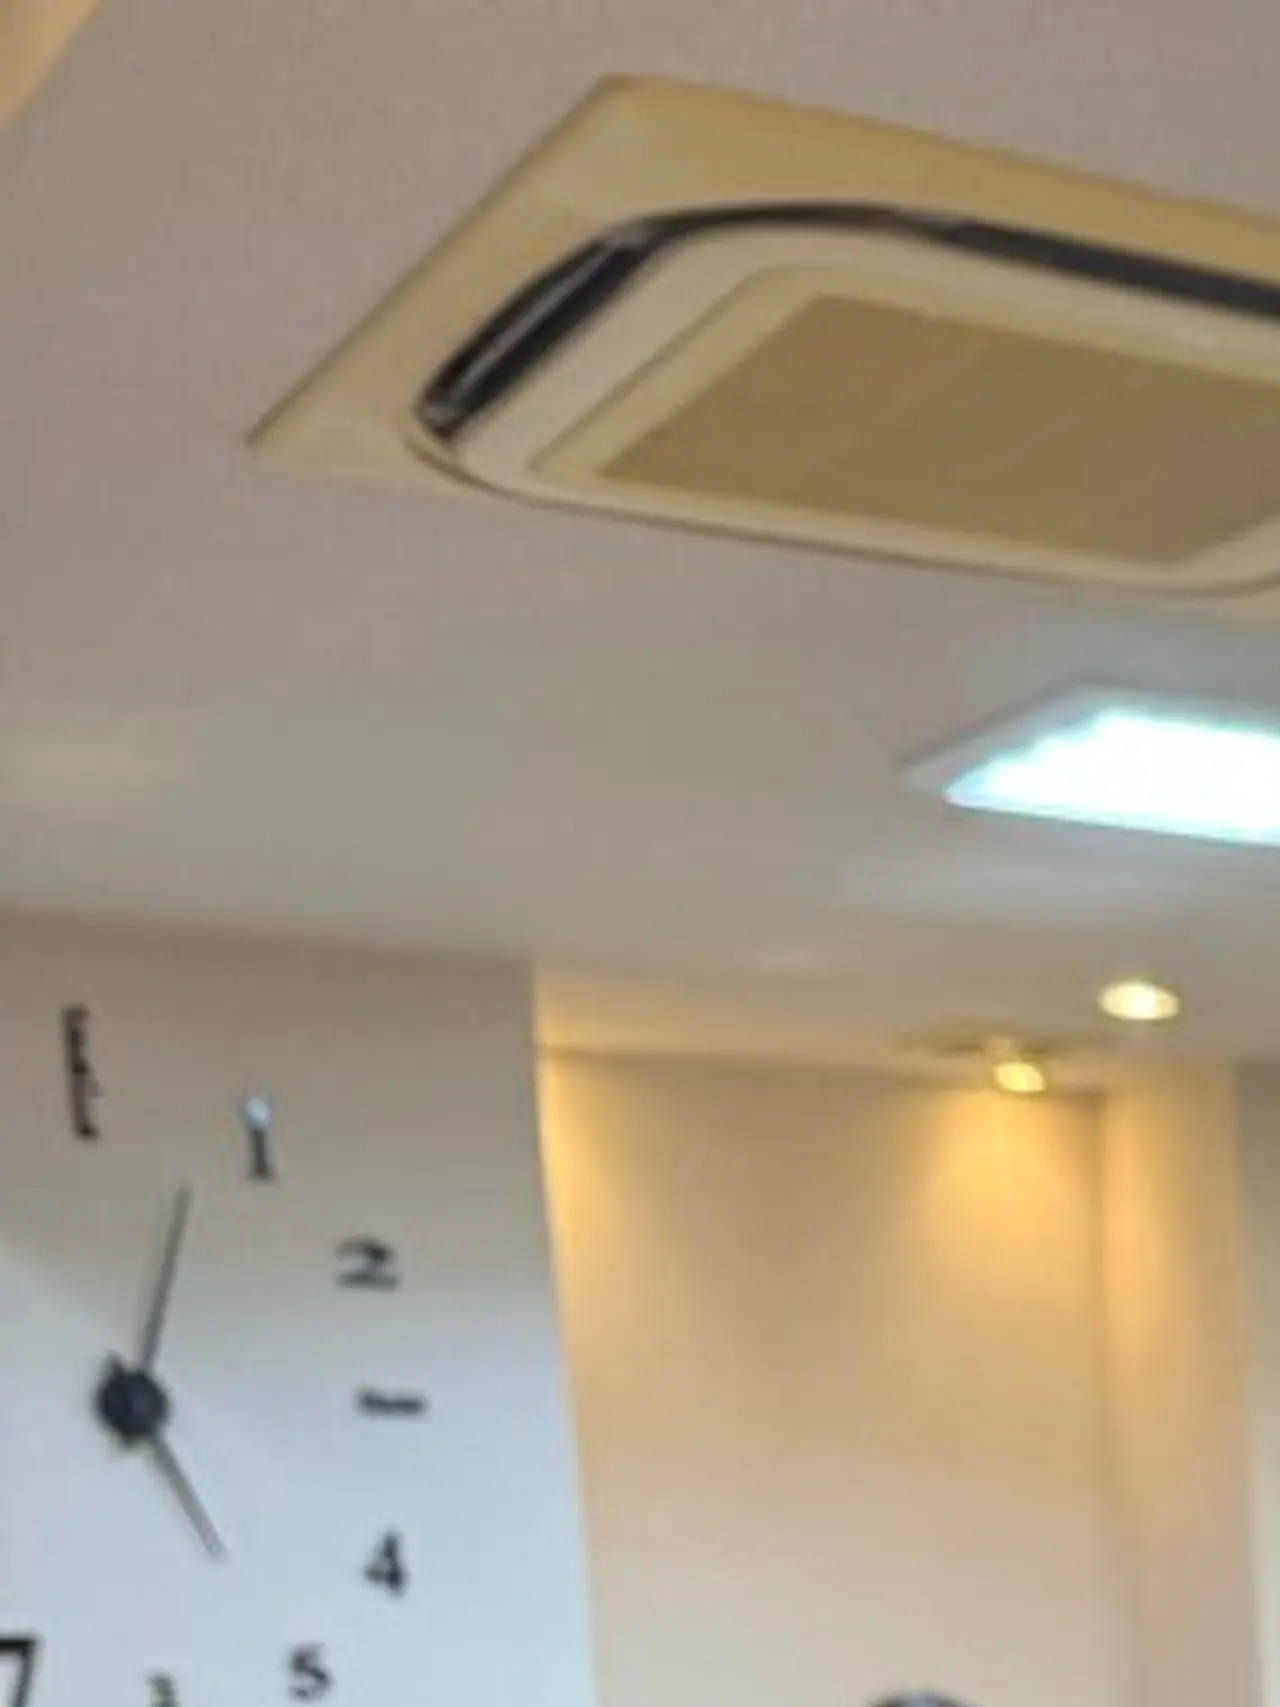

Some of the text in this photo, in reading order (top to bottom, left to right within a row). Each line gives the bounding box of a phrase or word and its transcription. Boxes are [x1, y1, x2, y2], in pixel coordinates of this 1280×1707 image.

[335, 1237, 401, 1289] 2
[364, 1530, 408, 1600] 4
[289, 1643, 332, 1702] 5
